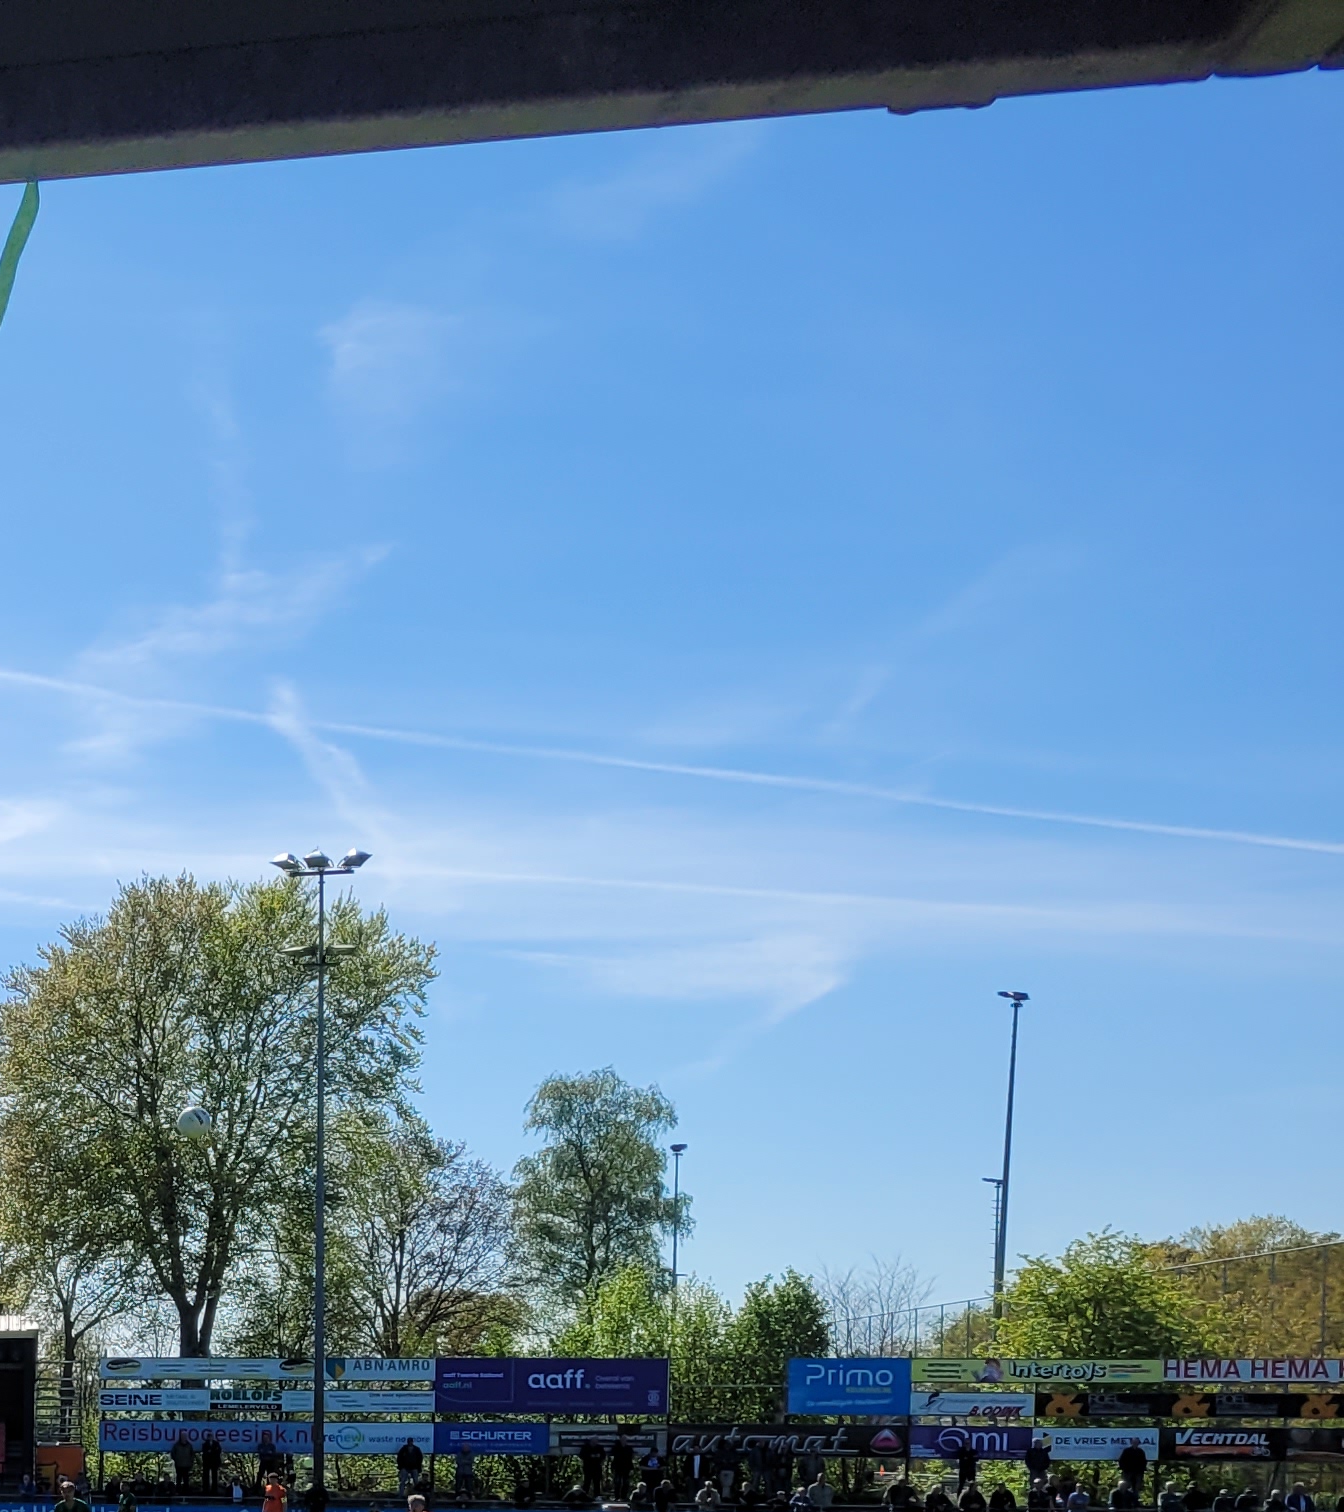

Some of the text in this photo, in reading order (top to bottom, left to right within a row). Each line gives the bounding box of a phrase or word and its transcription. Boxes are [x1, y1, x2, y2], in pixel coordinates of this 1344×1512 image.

[806, 1364, 894, 1386] Primo
[1008, 1361, 1106, 1380] Intertoys
[1164, 1361, 1241, 1378] HEMA
[1251, 1361, 1329, 1379] HEMA
[100, 1394, 162, 1406] SEINE
[210, 1389, 283, 1401] ROELOFS
[462, 1431, 532, 1440] SCHURTER
[1055, 1436, 1071, 1445] DE
[1073, 1436, 1107, 1445] VRIES
[1175, 1429, 1271, 1446] VECHTDAL
